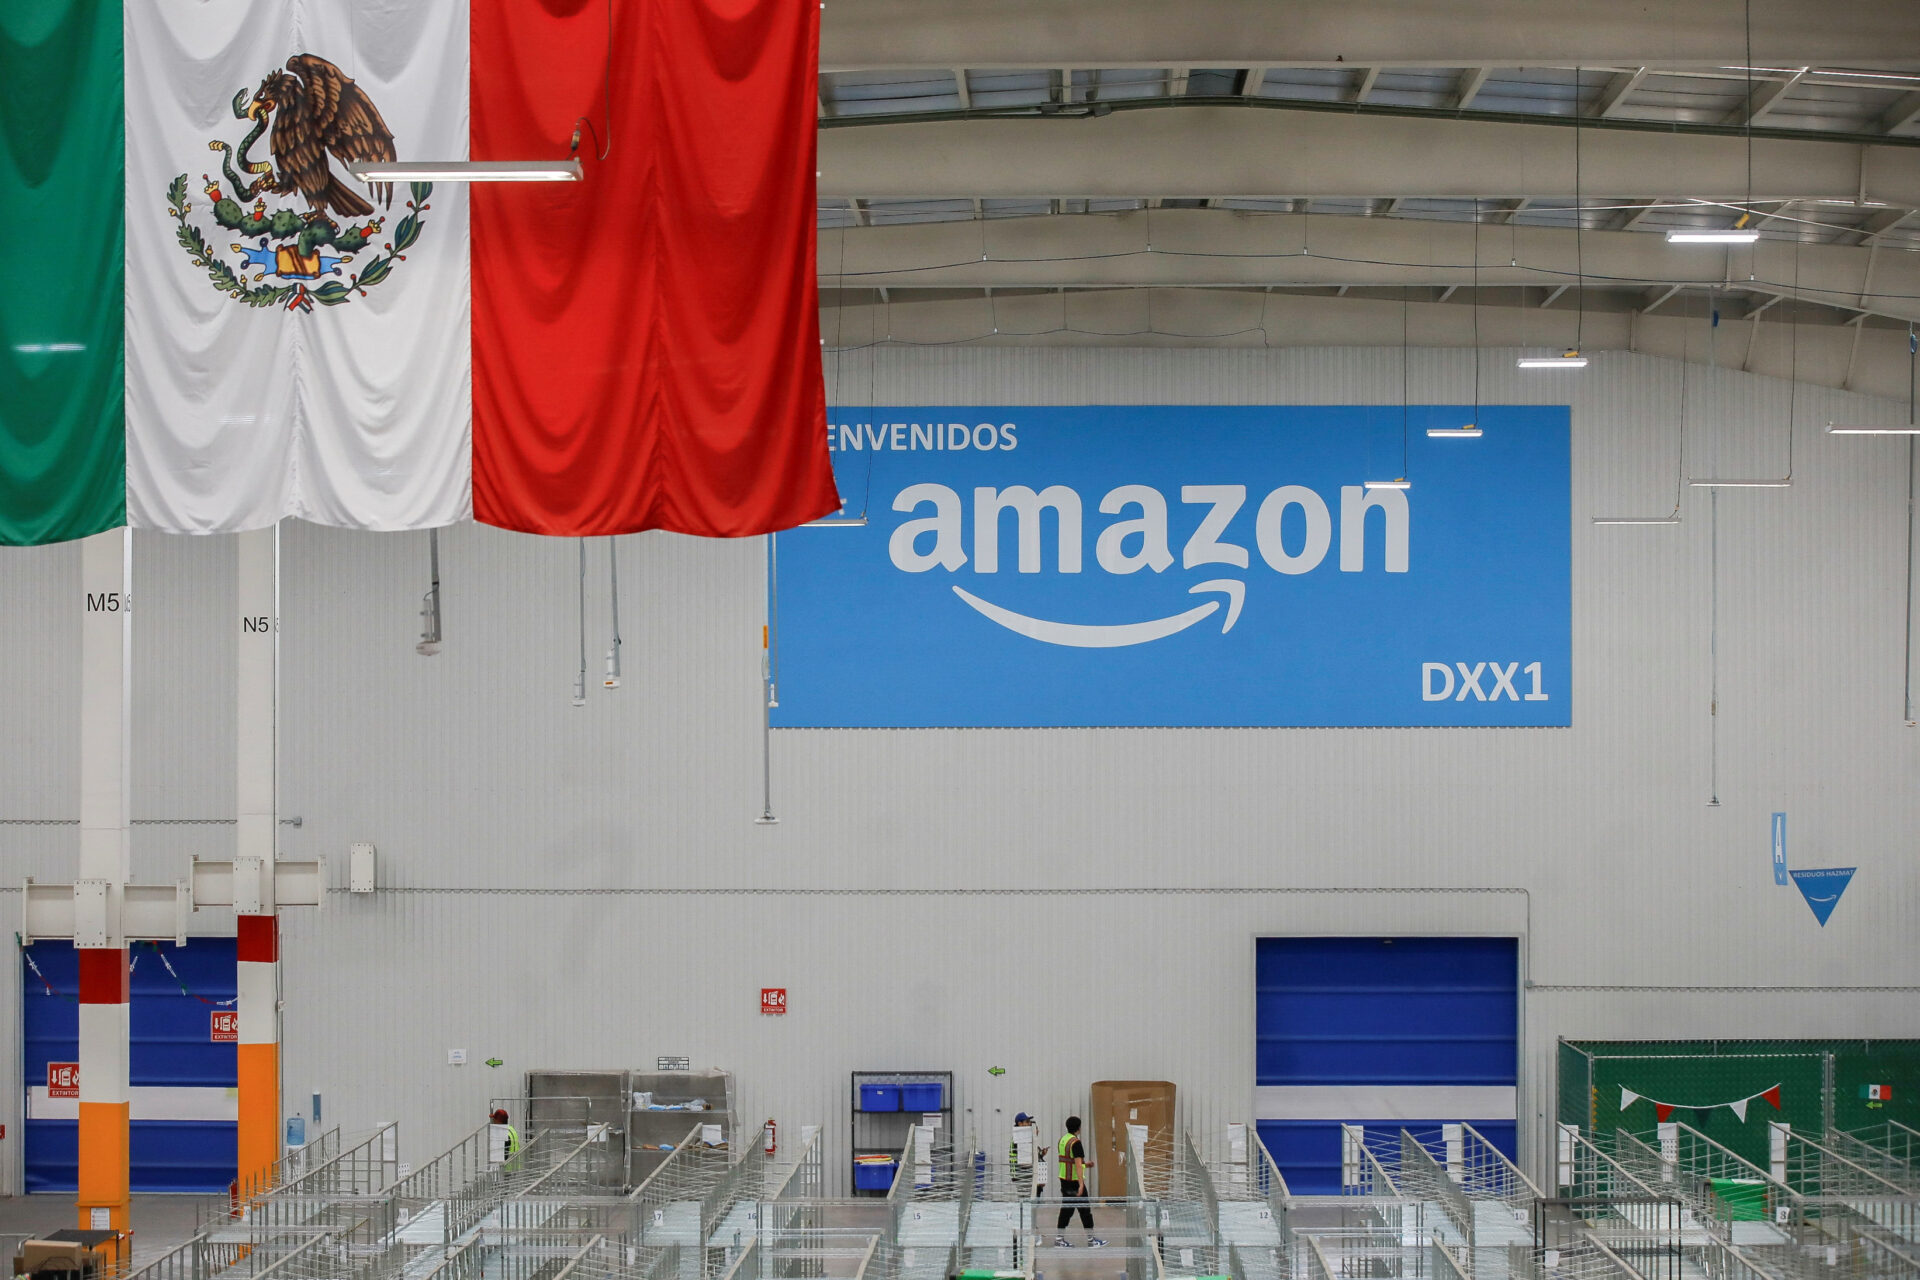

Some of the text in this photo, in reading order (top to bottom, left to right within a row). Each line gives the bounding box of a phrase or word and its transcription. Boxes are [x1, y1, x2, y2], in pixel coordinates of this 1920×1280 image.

[889, 483, 1410, 575] amazon
[87, 593, 120, 612] M5
[243, 617, 269, 633] N5
[1422, 661, 1549, 701] DXX1
[653, 1213, 662, 1221] 17
[913, 1212, 921, 1220] 15
[1259, 1211, 1269, 1219] 12
[1514, 1212, 1525, 1221] 10
[1780, 1210, 1787, 1220] 8
